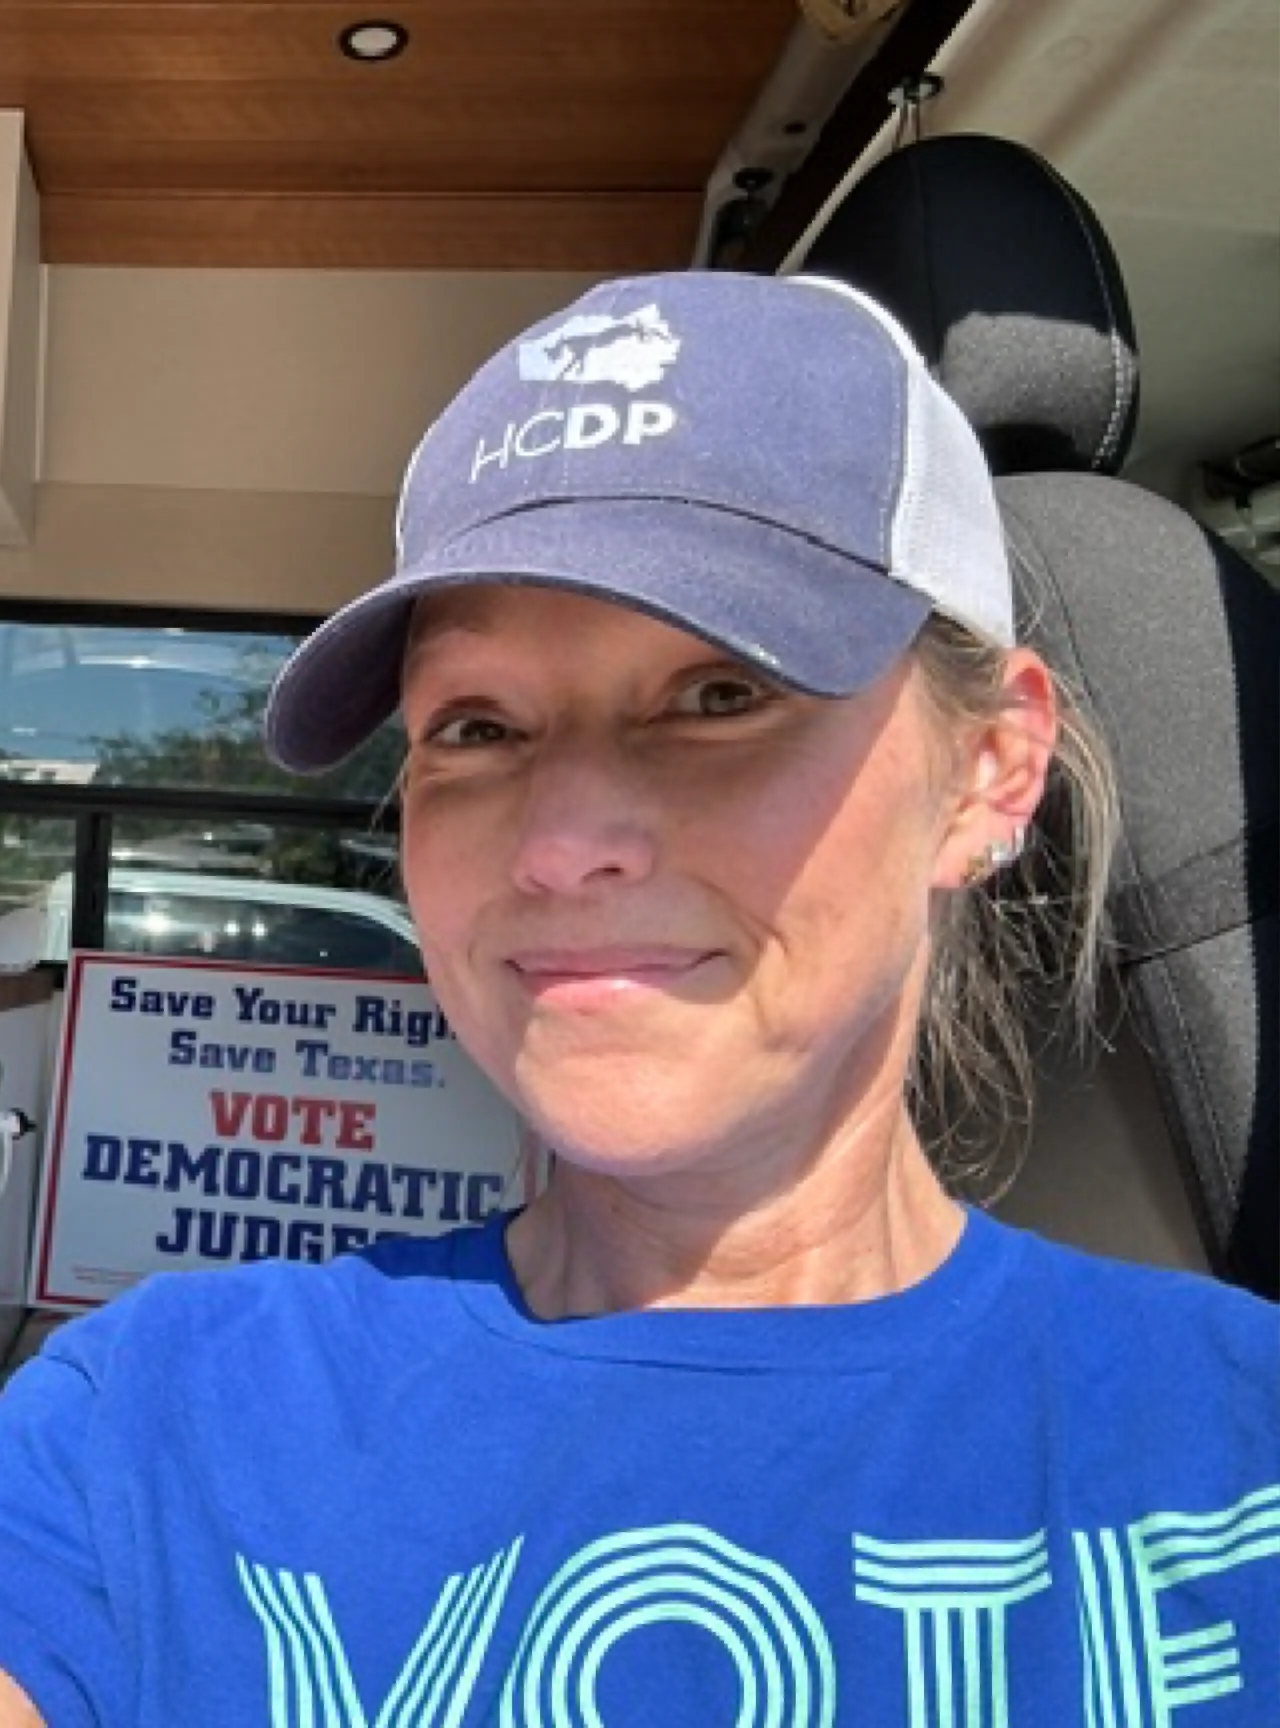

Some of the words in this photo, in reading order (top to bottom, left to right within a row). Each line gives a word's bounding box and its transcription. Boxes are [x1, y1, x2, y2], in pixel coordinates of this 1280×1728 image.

[468, 403, 677, 484] HCDP
[110, 977, 217, 1022] Save
[233, 986, 337, 1034] Your
[168, 1031, 276, 1074] Save
[295, 1039, 445, 1089] Texas.
[208, 1090, 377, 1151] VOTE
[82, 1134, 504, 1222] DEMOCRATIC
[155, 1207, 412, 1263] JUDGE
